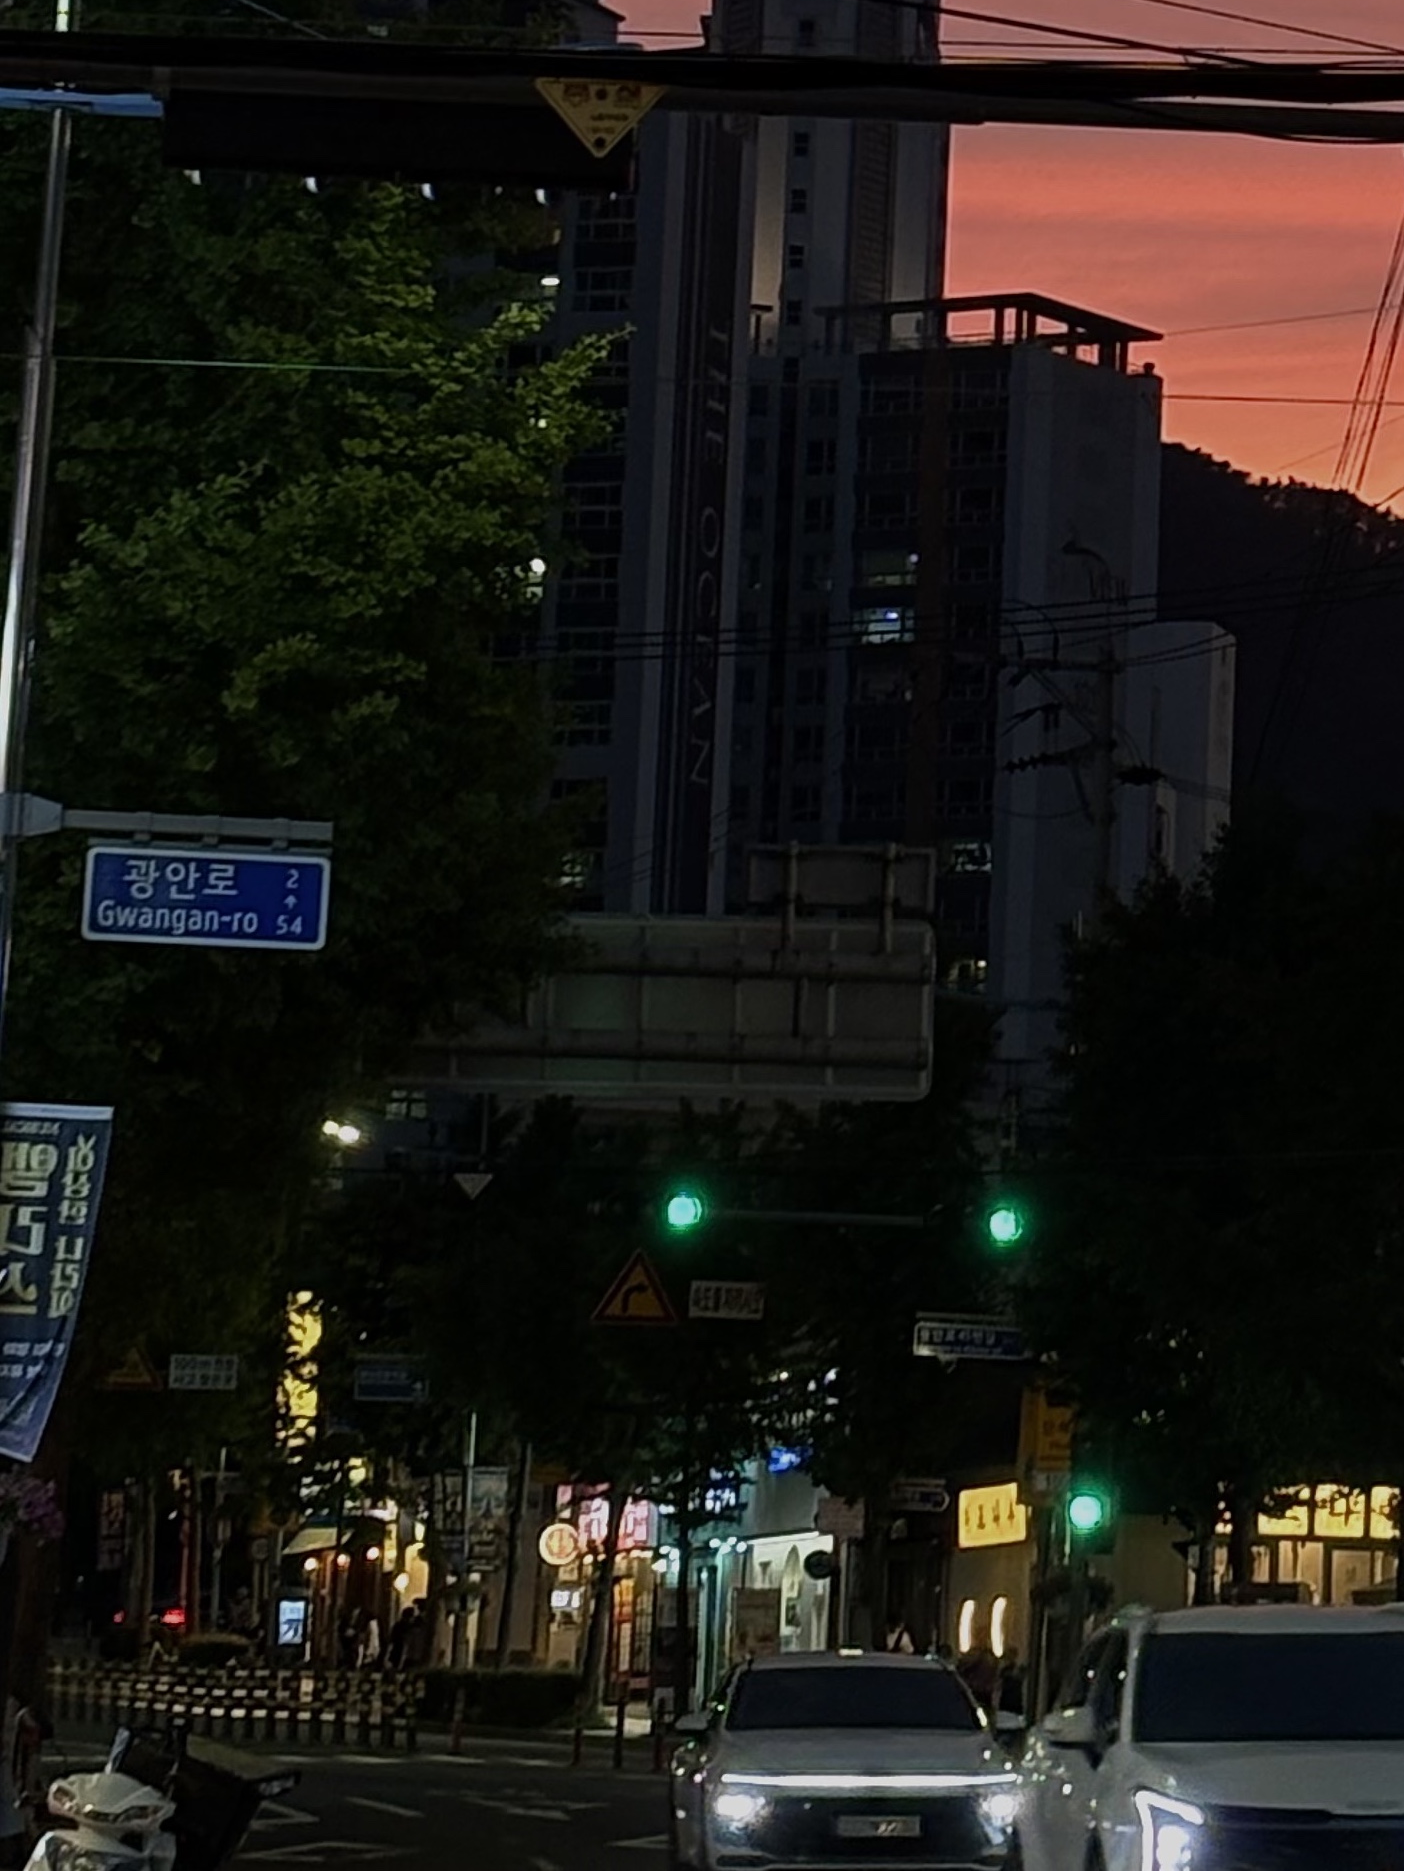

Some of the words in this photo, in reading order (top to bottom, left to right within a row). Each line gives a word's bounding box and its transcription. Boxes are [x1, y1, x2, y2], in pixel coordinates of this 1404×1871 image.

[702, 324, 730, 467] THE
[687, 503, 722, 786] OCEAN
[122, 858, 239, 900] 광안로
[284, 868, 299, 889] 2
[97, 900, 259, 936] Gwangan-ro
[275, 914, 303, 935] 54
